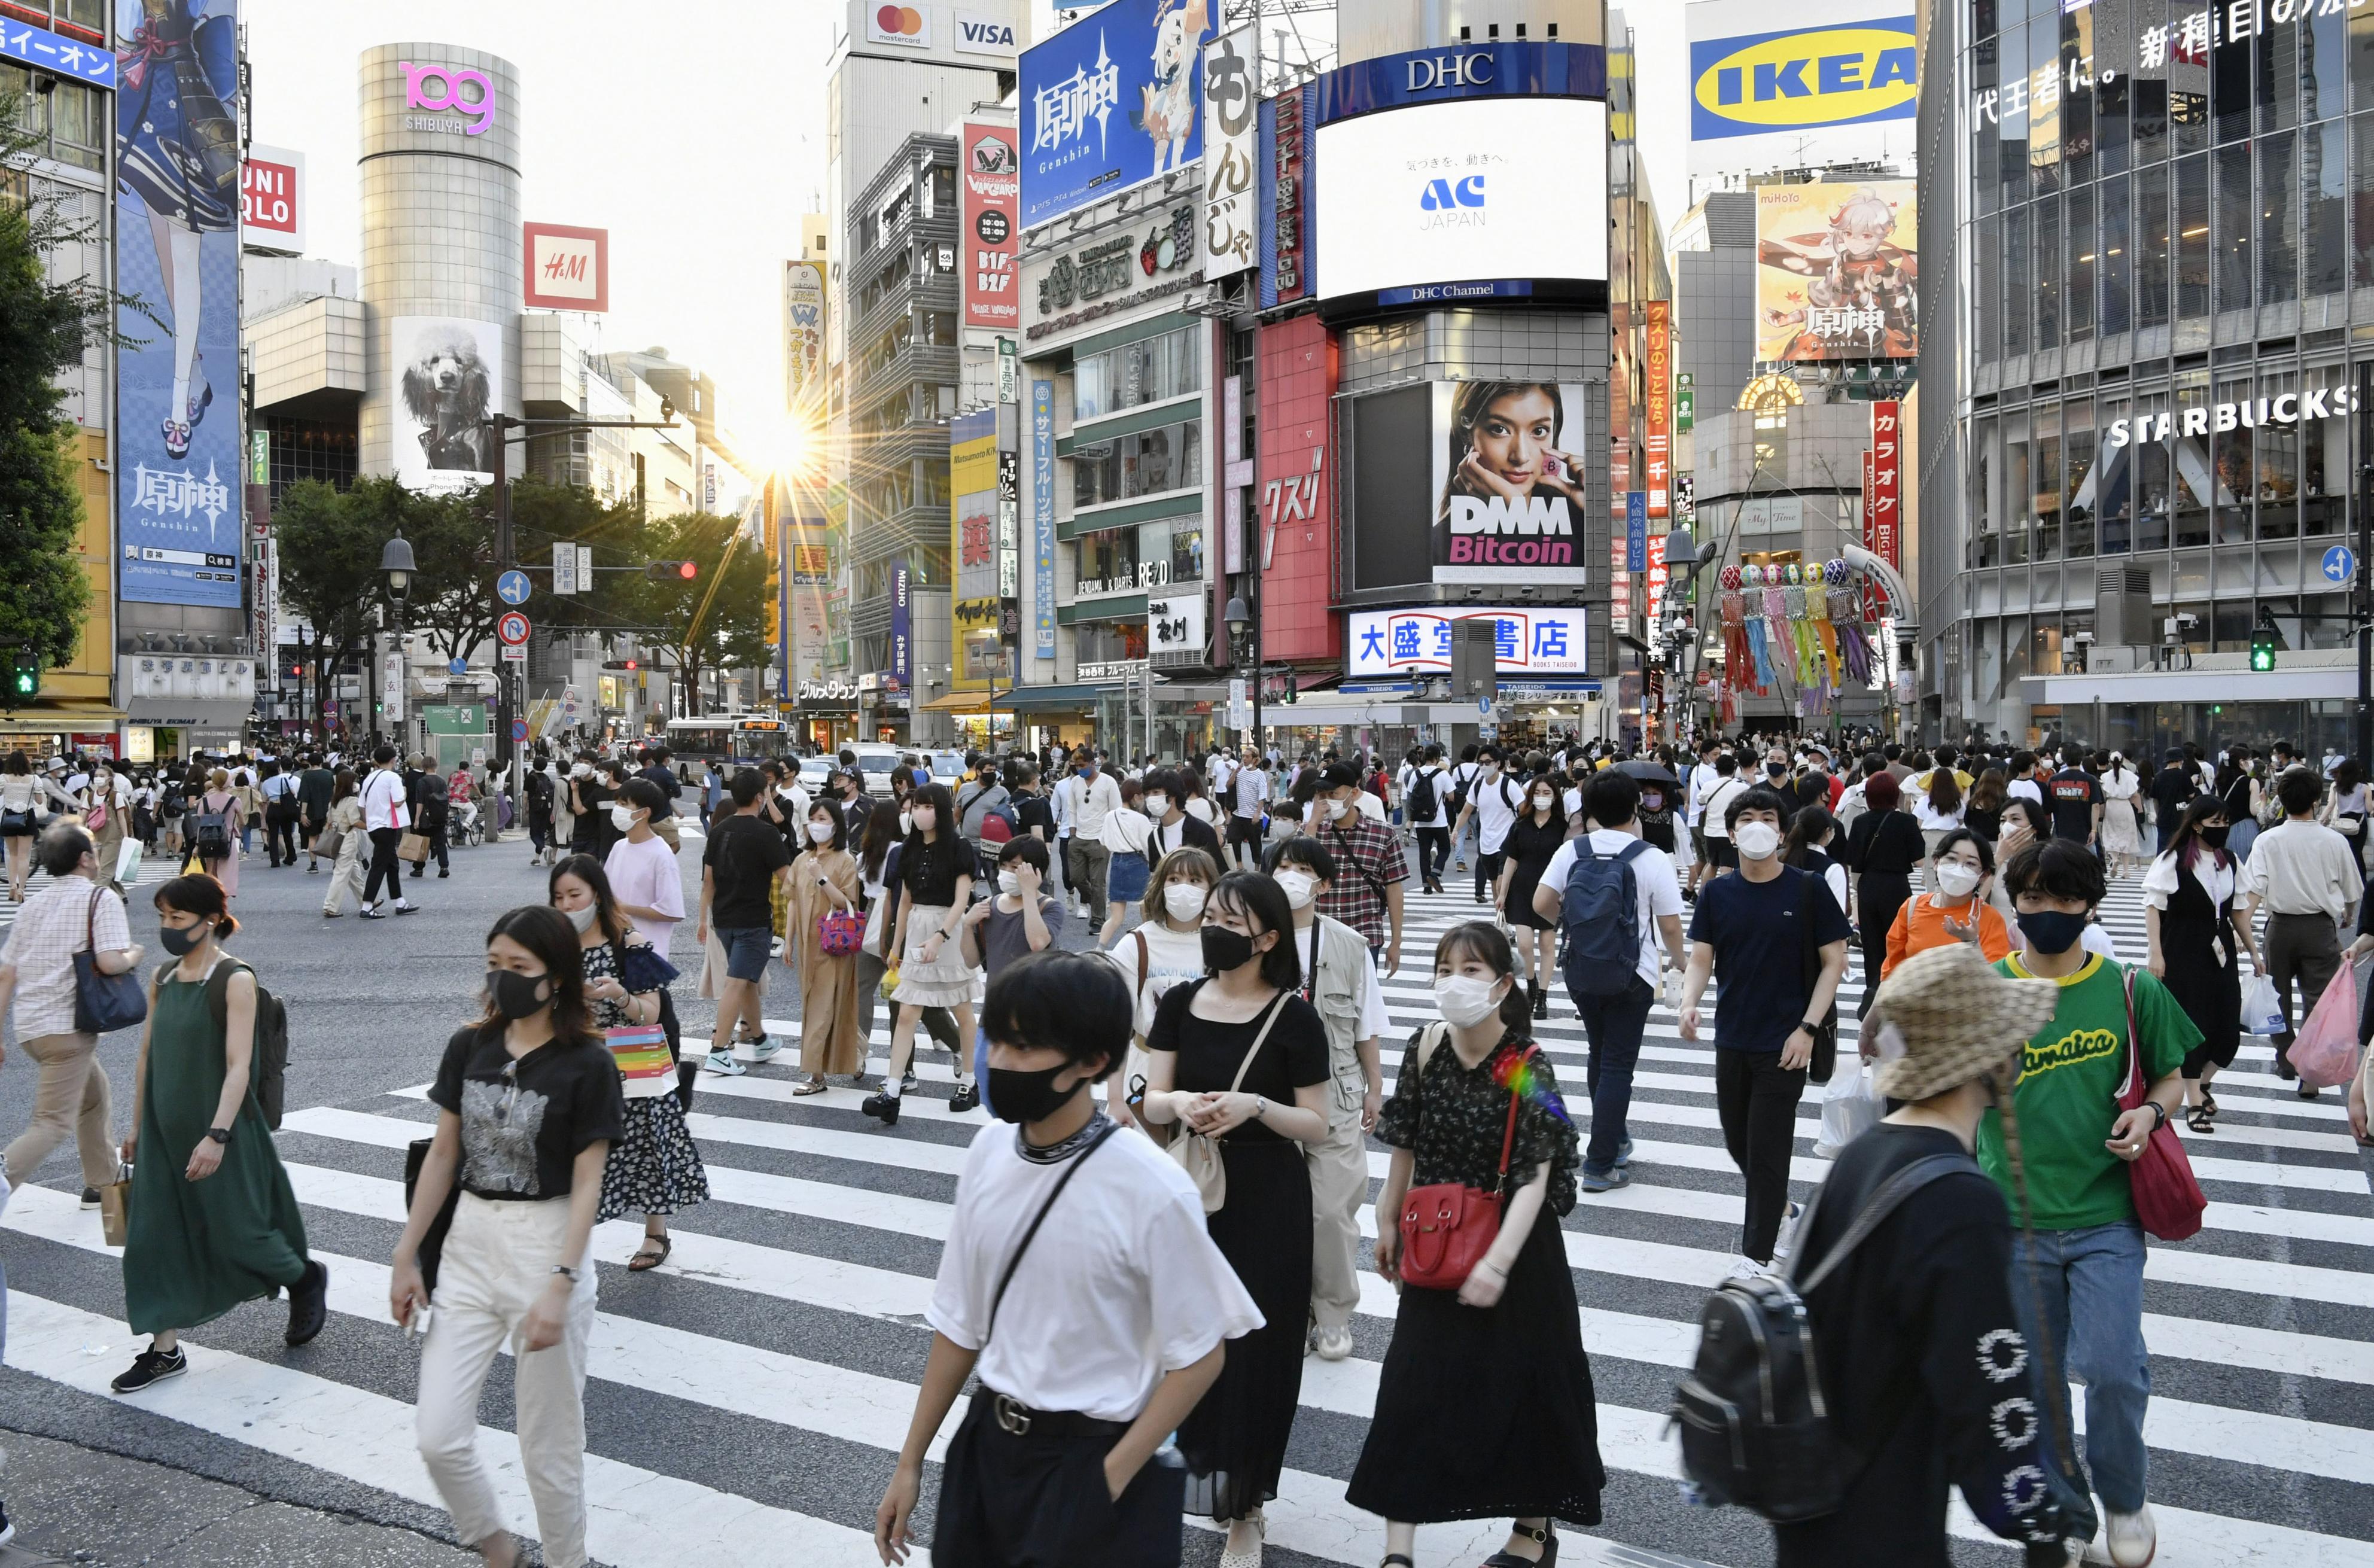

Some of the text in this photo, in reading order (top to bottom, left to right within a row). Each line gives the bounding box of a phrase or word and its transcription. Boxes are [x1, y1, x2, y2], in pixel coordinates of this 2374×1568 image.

[0, 20, 109, 75] イーオン
[879, 33, 921, 45] mastercard
[959, 20, 1014, 46] VISA
[1406, 52, 1493, 92] DHC
[1718, 46, 1915, 106] IKEA
[398, 60, 495, 136] 109
[1030, 27, 1119, 161] 原神
[406, 116, 461, 135] SHIBUYA
[1039, 145, 1090, 174] Genshin
[1206, 38, 1252, 266] もんじゃ
[1406, 153, 1509, 172] 気づきを、動きへ。
[1036, 193, 1067, 210] PS5 PS4
[1274, 95, 1298, 291] 三千里薬品
[1420, 175, 1485, 211] AC
[1761, 192, 1800, 204] miHoYo
[243, 195, 289, 225] QLO
[1420, 211, 1486, 231] JAPAN
[544, 252, 588, 282] H&M
[978, 251, 1009, 270] B1F
[978, 272, 1011, 292] B2F
[1411, 282, 1495, 299] DHC Channel
[971, 303, 1016, 317] VILLAGE VANGUARD
[1803, 290, 1886, 353] 原神
[1810, 339, 1859, 349] Genshin
[1650, 306, 1666, 425] クスリのことなら
[2110, 384, 2359, 447] STARBUCKS
[254, 434, 265, 485] レイクAL
[954, 449, 985, 465] Matsumoto
[1648, 434, 1668, 508] 三千里
[1876, 415, 1896, 513] カラオケ
[1000, 468, 1008, 483] バー
[1036, 416, 1051, 556] サマーフルーツギフト
[130, 456, 228, 544] 原神
[1263, 446, 1323, 570] クスリ
[1450, 495, 1574, 535] DMM
[140, 518, 199, 532] Genshin
[1631, 497, 1643, 568] 大盛堂商事ビル
[1748, 512, 1797, 526] My Time
[961, 514, 991, 566] 薬
[1448, 535, 1572, 565] Bitcoin
[1877, 525, 1891, 549] BIG
[217, 557, 232, 566] 検索
[563, 547, 573, 590] 渋谷駅前
[1138, 559, 1168, 587] RE/D
[257, 562, 267, 608] Miami
[897, 569, 906, 608] MIZUHO
[1108, 579, 1112, 591] &
[1114, 575, 1133, 590] DARTS
[1005, 608, 1017, 635] HUB
[1149, 601, 1168, 615] うなぎ
[1156, 616, 1187, 644] 松川
[142, 659, 248, 674] 渋谷駅前ビル
[897, 635, 906, 675] みずほ銀行
[386, 659, 397, 714] 道玄坂
[1078, 666, 1105, 678] 渋谷西村
[799, 680, 859, 700] グルメタウン
[1320, 769, 1328, 778] B
[2017, 1030, 2115, 1080] amaica
